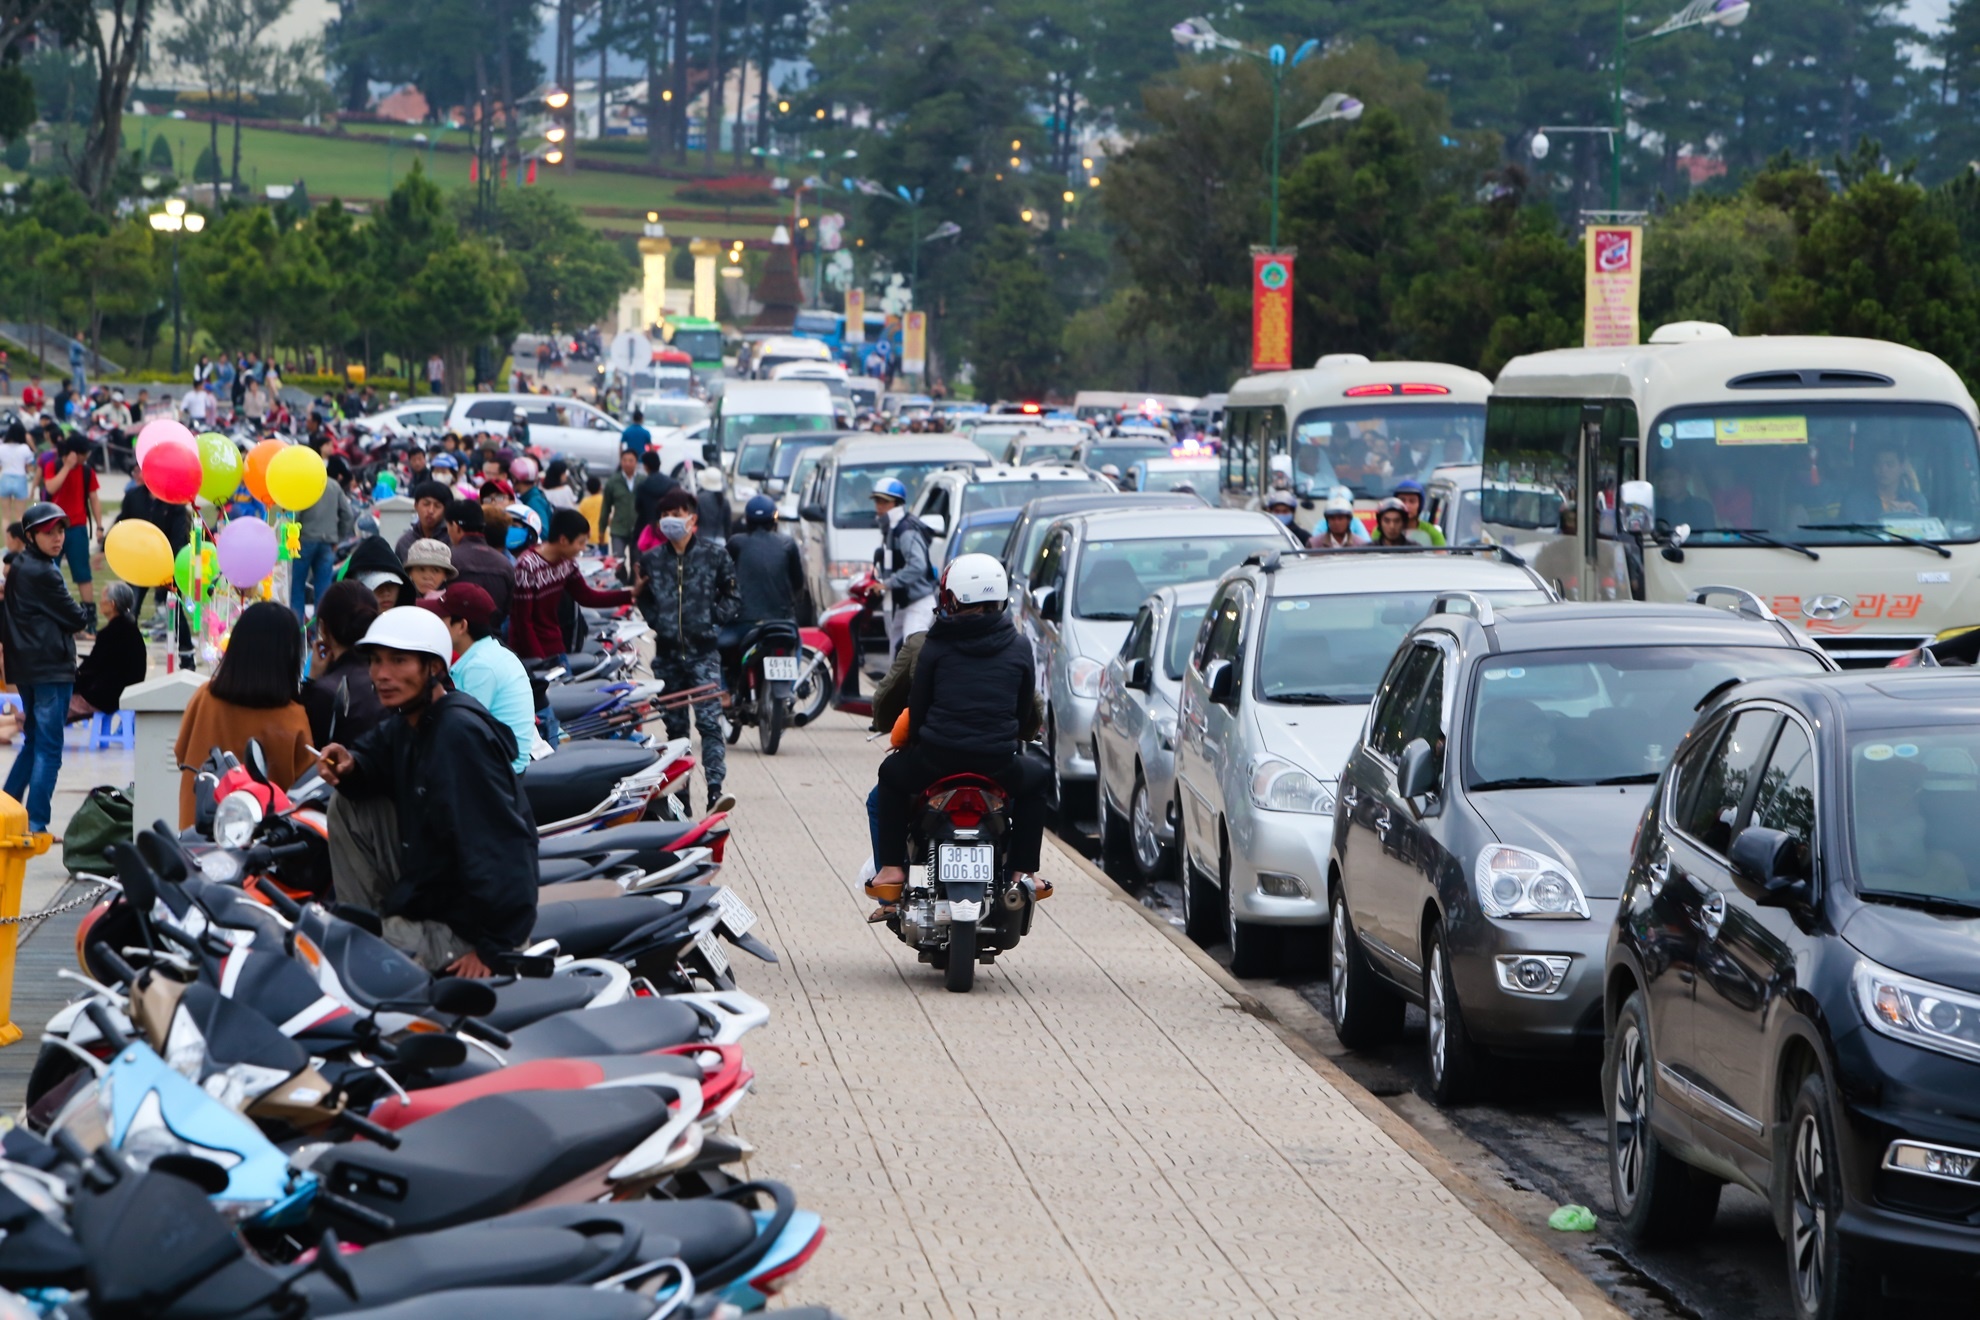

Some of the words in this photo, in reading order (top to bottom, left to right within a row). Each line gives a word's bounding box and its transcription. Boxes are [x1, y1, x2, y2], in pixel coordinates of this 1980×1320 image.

[1853, 593, 1924, 619] 관광
[947, 847, 985, 864] 38-D1
[943, 863, 990, 880] 006.89
